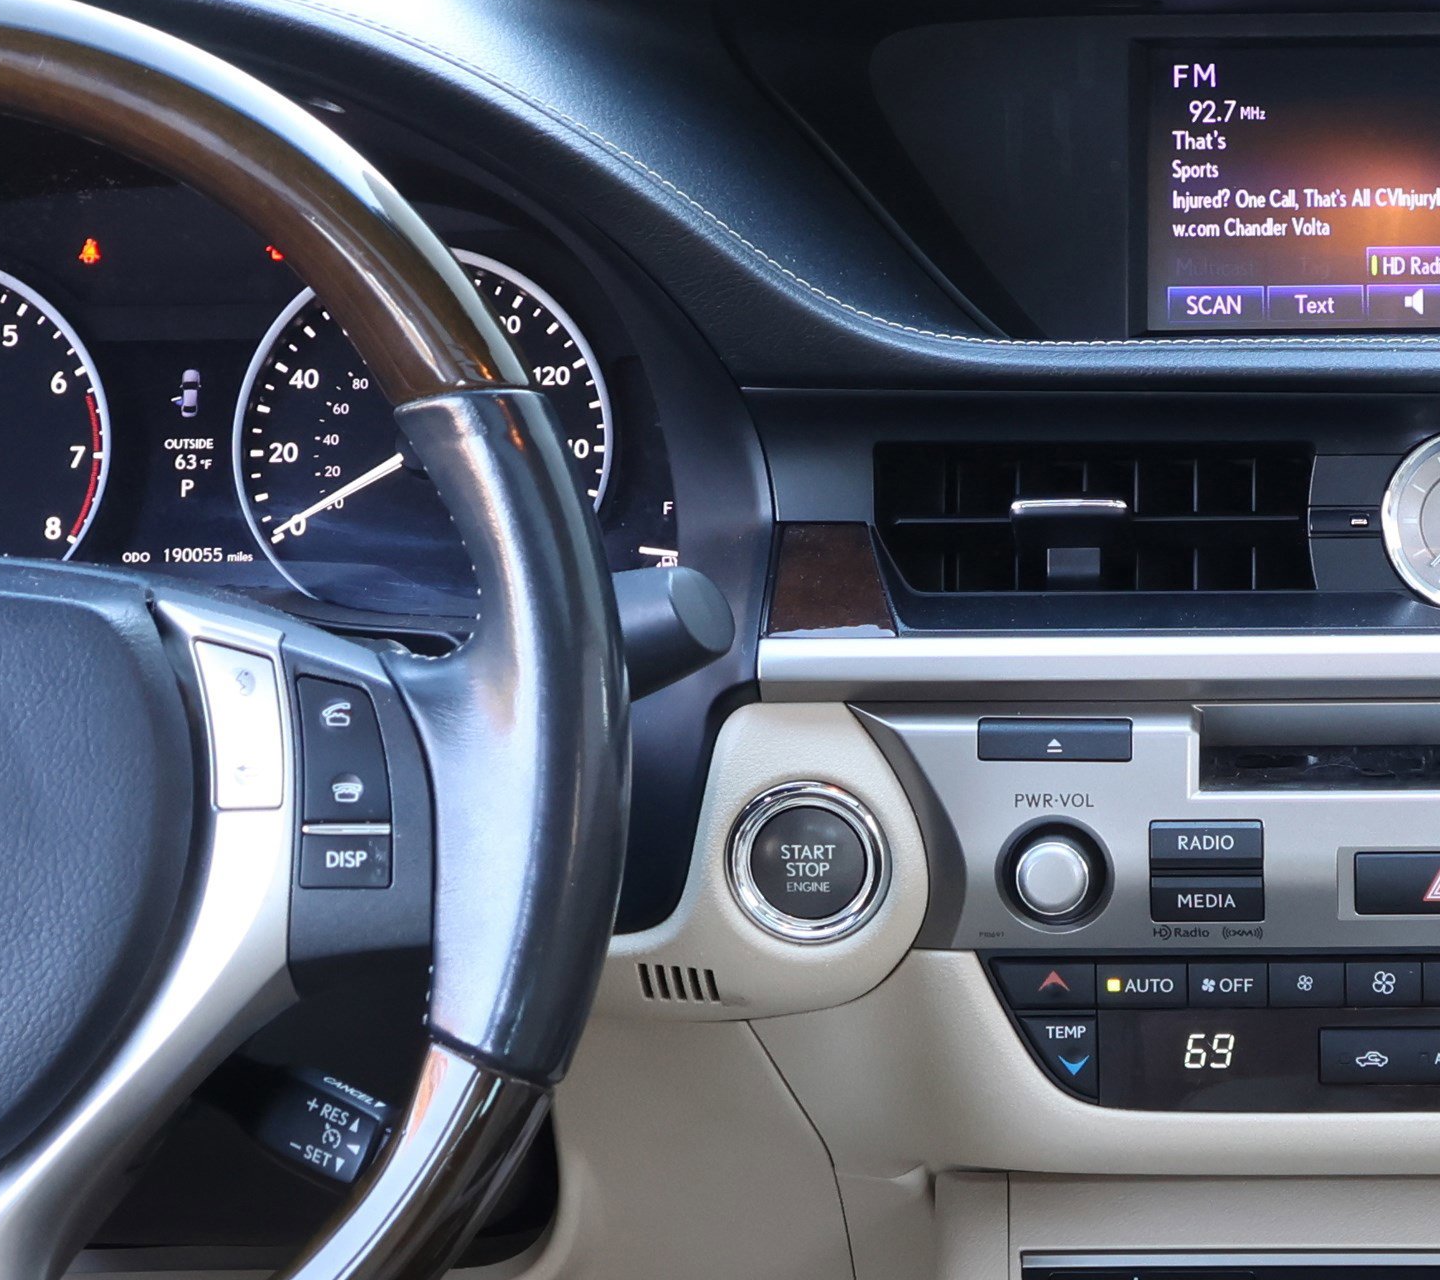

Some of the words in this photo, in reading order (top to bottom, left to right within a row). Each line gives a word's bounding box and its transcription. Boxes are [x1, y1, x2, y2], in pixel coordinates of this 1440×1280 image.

[1172, 63, 1216, 89] FM
[1189, 100, 1237, 124] 92.7
[1240, 106, 1266, 120] MHz
[1172, 130, 1227, 151] That's
[1172, 159, 1219, 183] Sports
[1172, 189, 1230, 213] Injured?
[1235, 191, 1266, 209] One
[1269, 188, 1300, 211] Call,
[1303, 188, 1347, 208] That's
[1351, 188, 1371, 208] All
[1172, 222, 1220, 237] w.com
[1223, 218, 1288, 237] Chandler
[1291, 216, 1331, 237] Volta
[1382, 257, 1406, 275] HD
[1186, 294, 1242, 315] SCAN
[1294, 294, 1335, 314] Text
[1, 324, 19, 348] 5
[49, 371, 68, 395] 6
[288, 369, 320, 390] 40
[351, 378, 369, 391] 80
[332, 403, 350, 416] 60
[164, 438, 215, 450] OUTSIDE
[322, 433, 340, 446] 40
[69, 445, 87, 469] 7
[268, 442, 299, 463] 20
[174, 454, 198, 470] 63
[324, 465, 341, 478] 20
[180, 479, 195, 498] P
[662, 501, 673, 516] F
[43, 516, 63, 540] 8
[121, 551, 151, 563] ODO
[163, 547, 224, 564] 190055
[227, 551, 254, 563] miles
[780, 844, 836, 860] START
[1177, 835, 1235, 851] RADIO
[325, 849, 367, 869] DISP
[786, 862, 830, 878] STOP
[786, 881, 831, 893] ENGINE
[1177, 894, 1236, 909] MEDIA
[1174, 927, 1210, 938] Radio
[1125, 978, 1175, 994] AUTO
[1219, 978, 1254, 994] OFF
[1046, 1025, 1087, 1040] TEMP
[1183, 1032, 1236, 1070] 69
[323, 1076, 375, 1105] CANCEL
